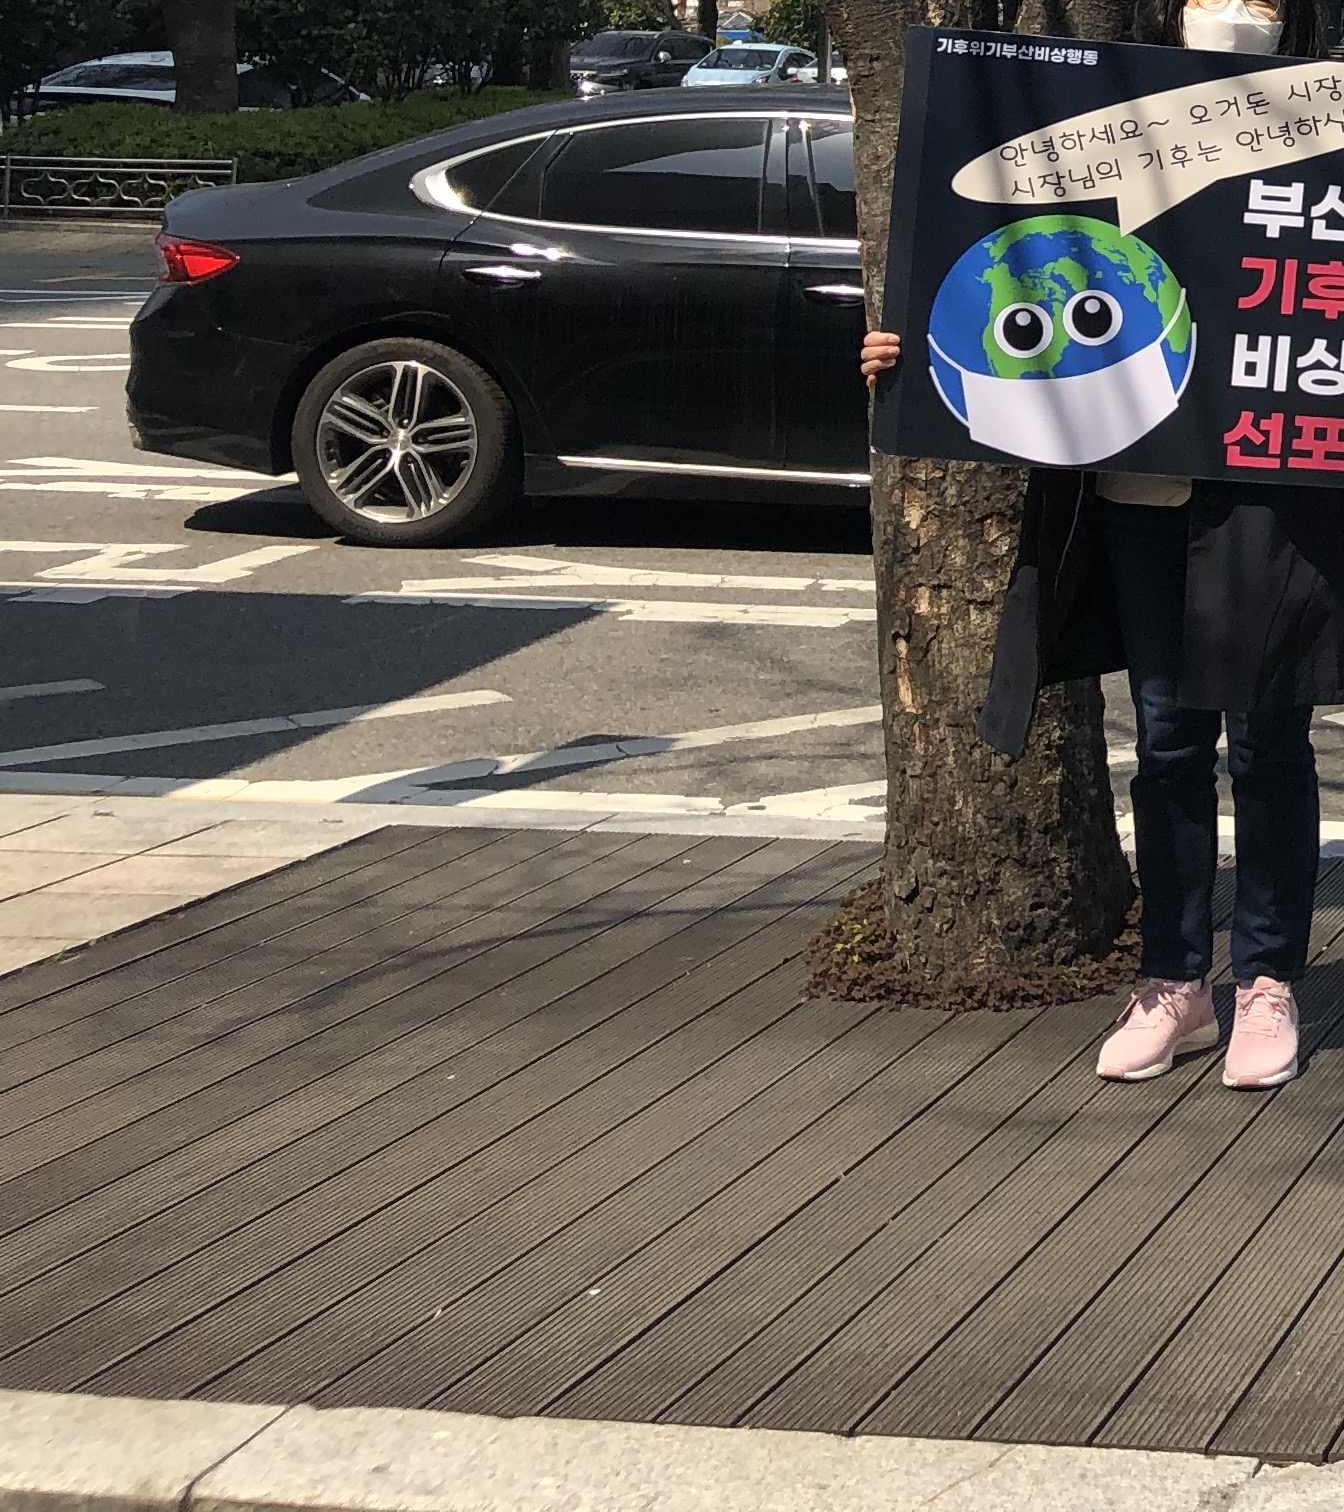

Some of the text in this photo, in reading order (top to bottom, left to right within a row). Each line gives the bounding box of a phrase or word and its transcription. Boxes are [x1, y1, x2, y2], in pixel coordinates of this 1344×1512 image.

[936, 37, 1100, 66] 기후위기부산비상행동
[1000, 117, 1170, 169] 안녕하세요~
[1188, 90, 1271, 126] 오거돈
[1011, 159, 1123, 198] 시장님의
[1140, 140, 1222, 171] 기후는
